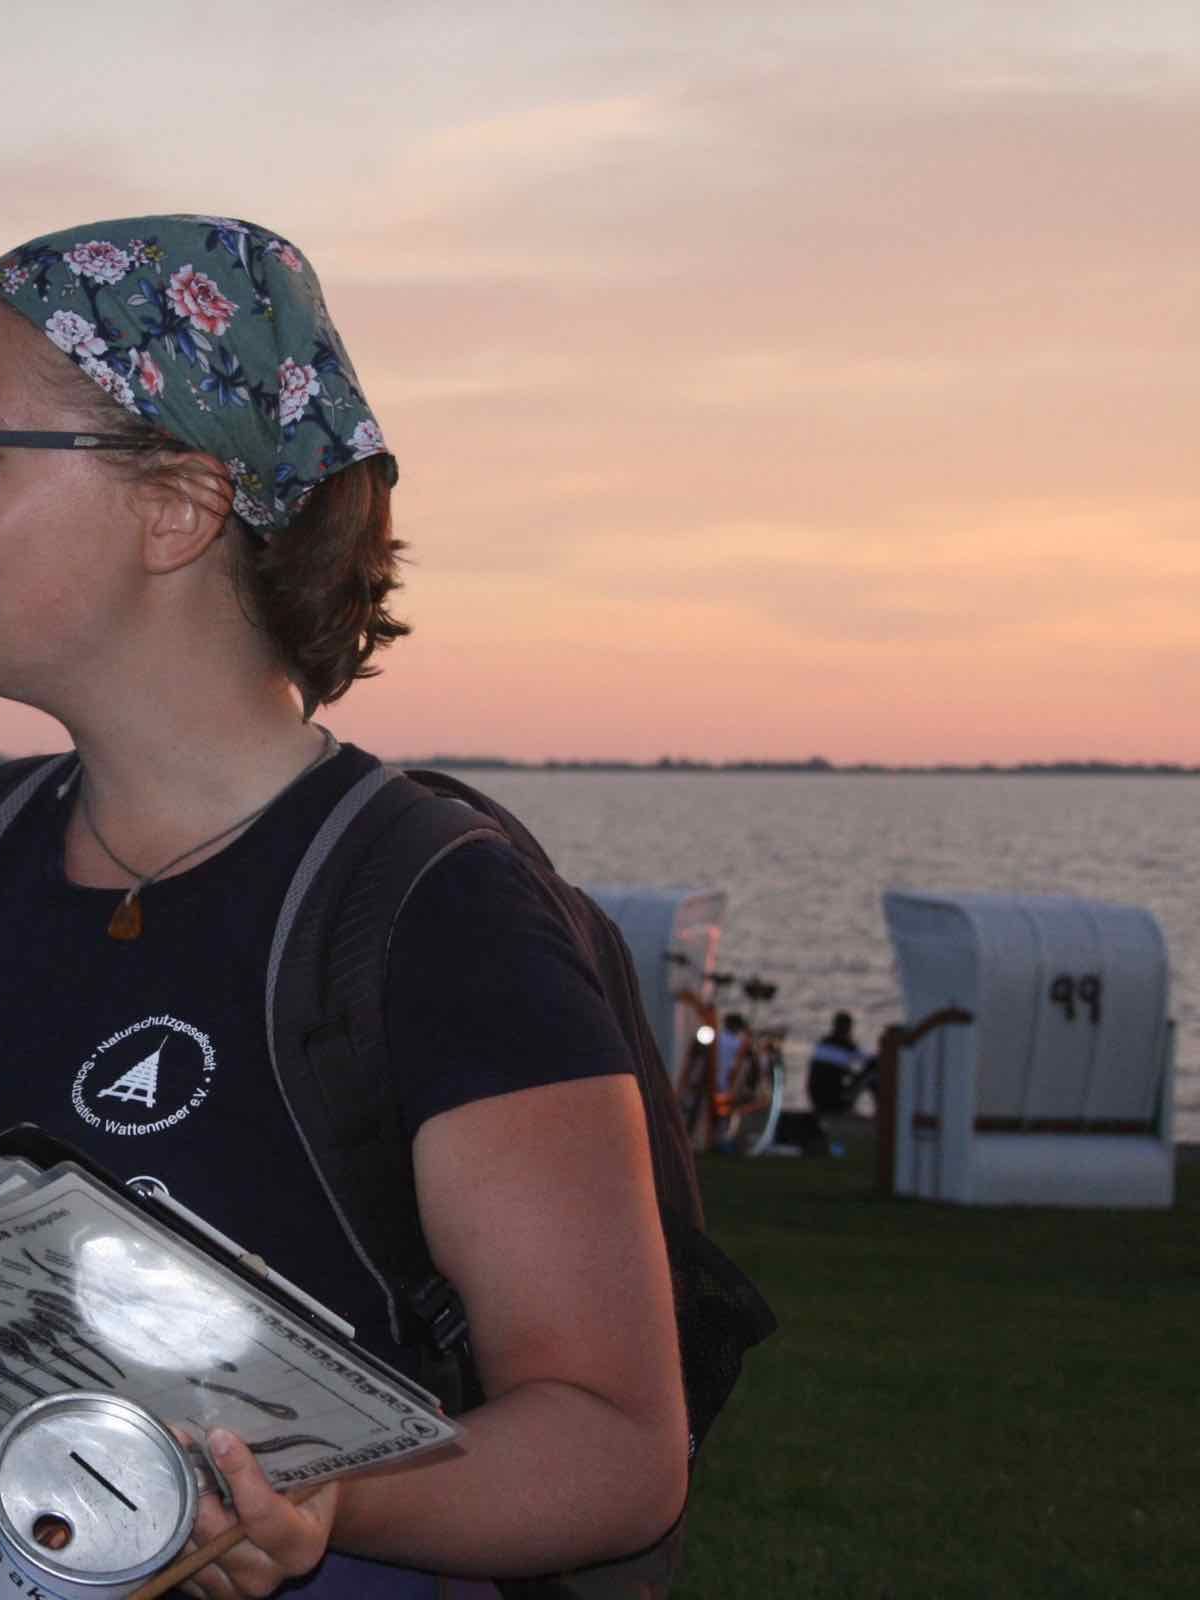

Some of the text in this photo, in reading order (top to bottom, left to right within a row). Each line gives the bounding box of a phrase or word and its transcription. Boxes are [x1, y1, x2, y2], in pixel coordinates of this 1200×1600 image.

[96, 1014, 216, 1072] Naturschutzgesellschaft
[71, 1060, 101, 1128] Schutzstation
[104, 1104, 191, 1136] Wattenmeer
